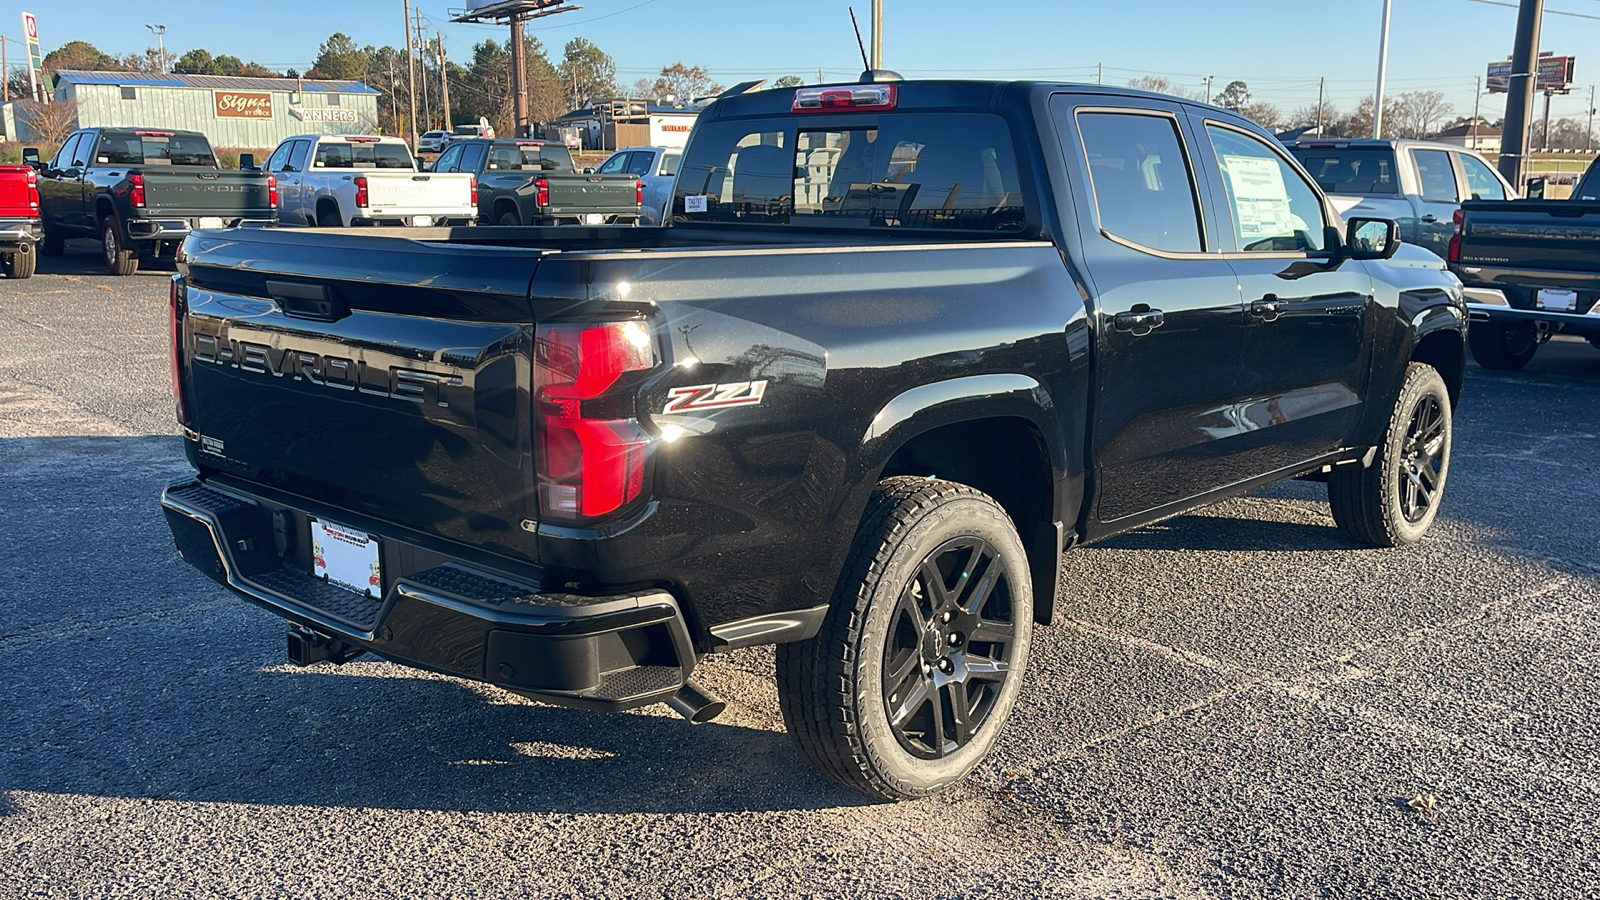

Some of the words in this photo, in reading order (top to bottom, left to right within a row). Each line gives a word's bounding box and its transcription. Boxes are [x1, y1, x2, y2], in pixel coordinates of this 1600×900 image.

[219, 94, 267, 112] Signs
[303, 110, 355, 121] ANNERS
[193, 332, 463, 408] CHEVROLET
[663, 380, 768, 414] Z71
